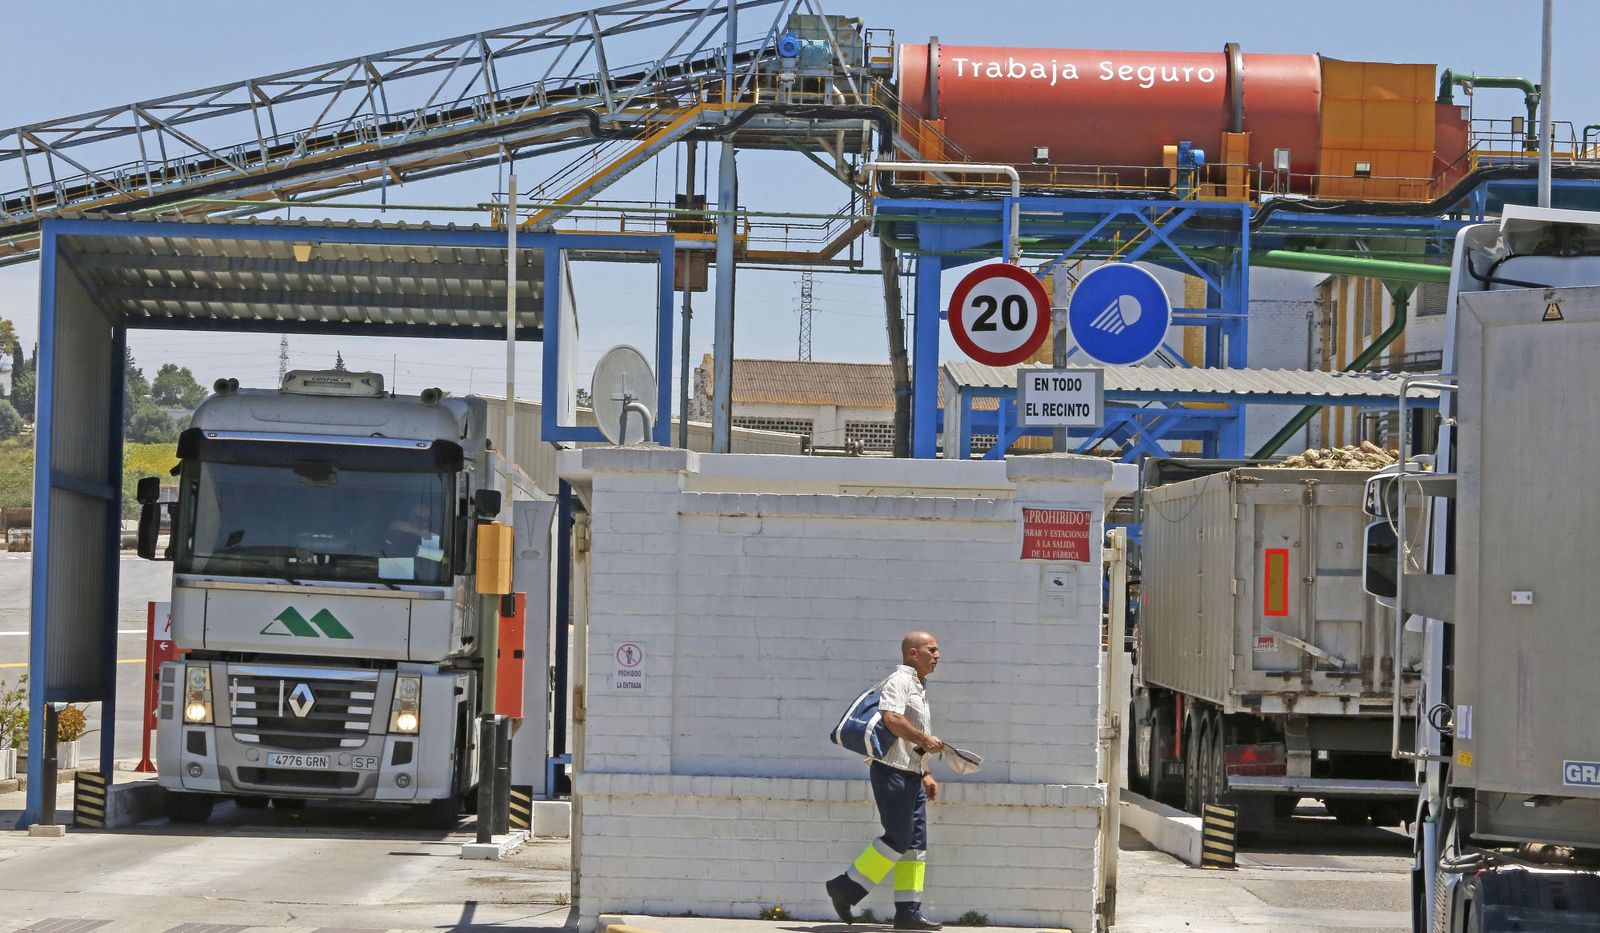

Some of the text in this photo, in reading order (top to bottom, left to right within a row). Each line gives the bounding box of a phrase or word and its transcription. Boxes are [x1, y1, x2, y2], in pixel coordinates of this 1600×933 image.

[952, 57, 1216, 88] Trabaja Seguro
[971, 294, 1028, 332] 20
[1034, 378, 1082, 392] EN TODO
[1026, 403, 1090, 417] EL RECINTO
[1052, 540, 1075, 548] SALIDA
[275, 755, 327, 768] 4776 GRN
[1566, 764, 1600, 783] GR
